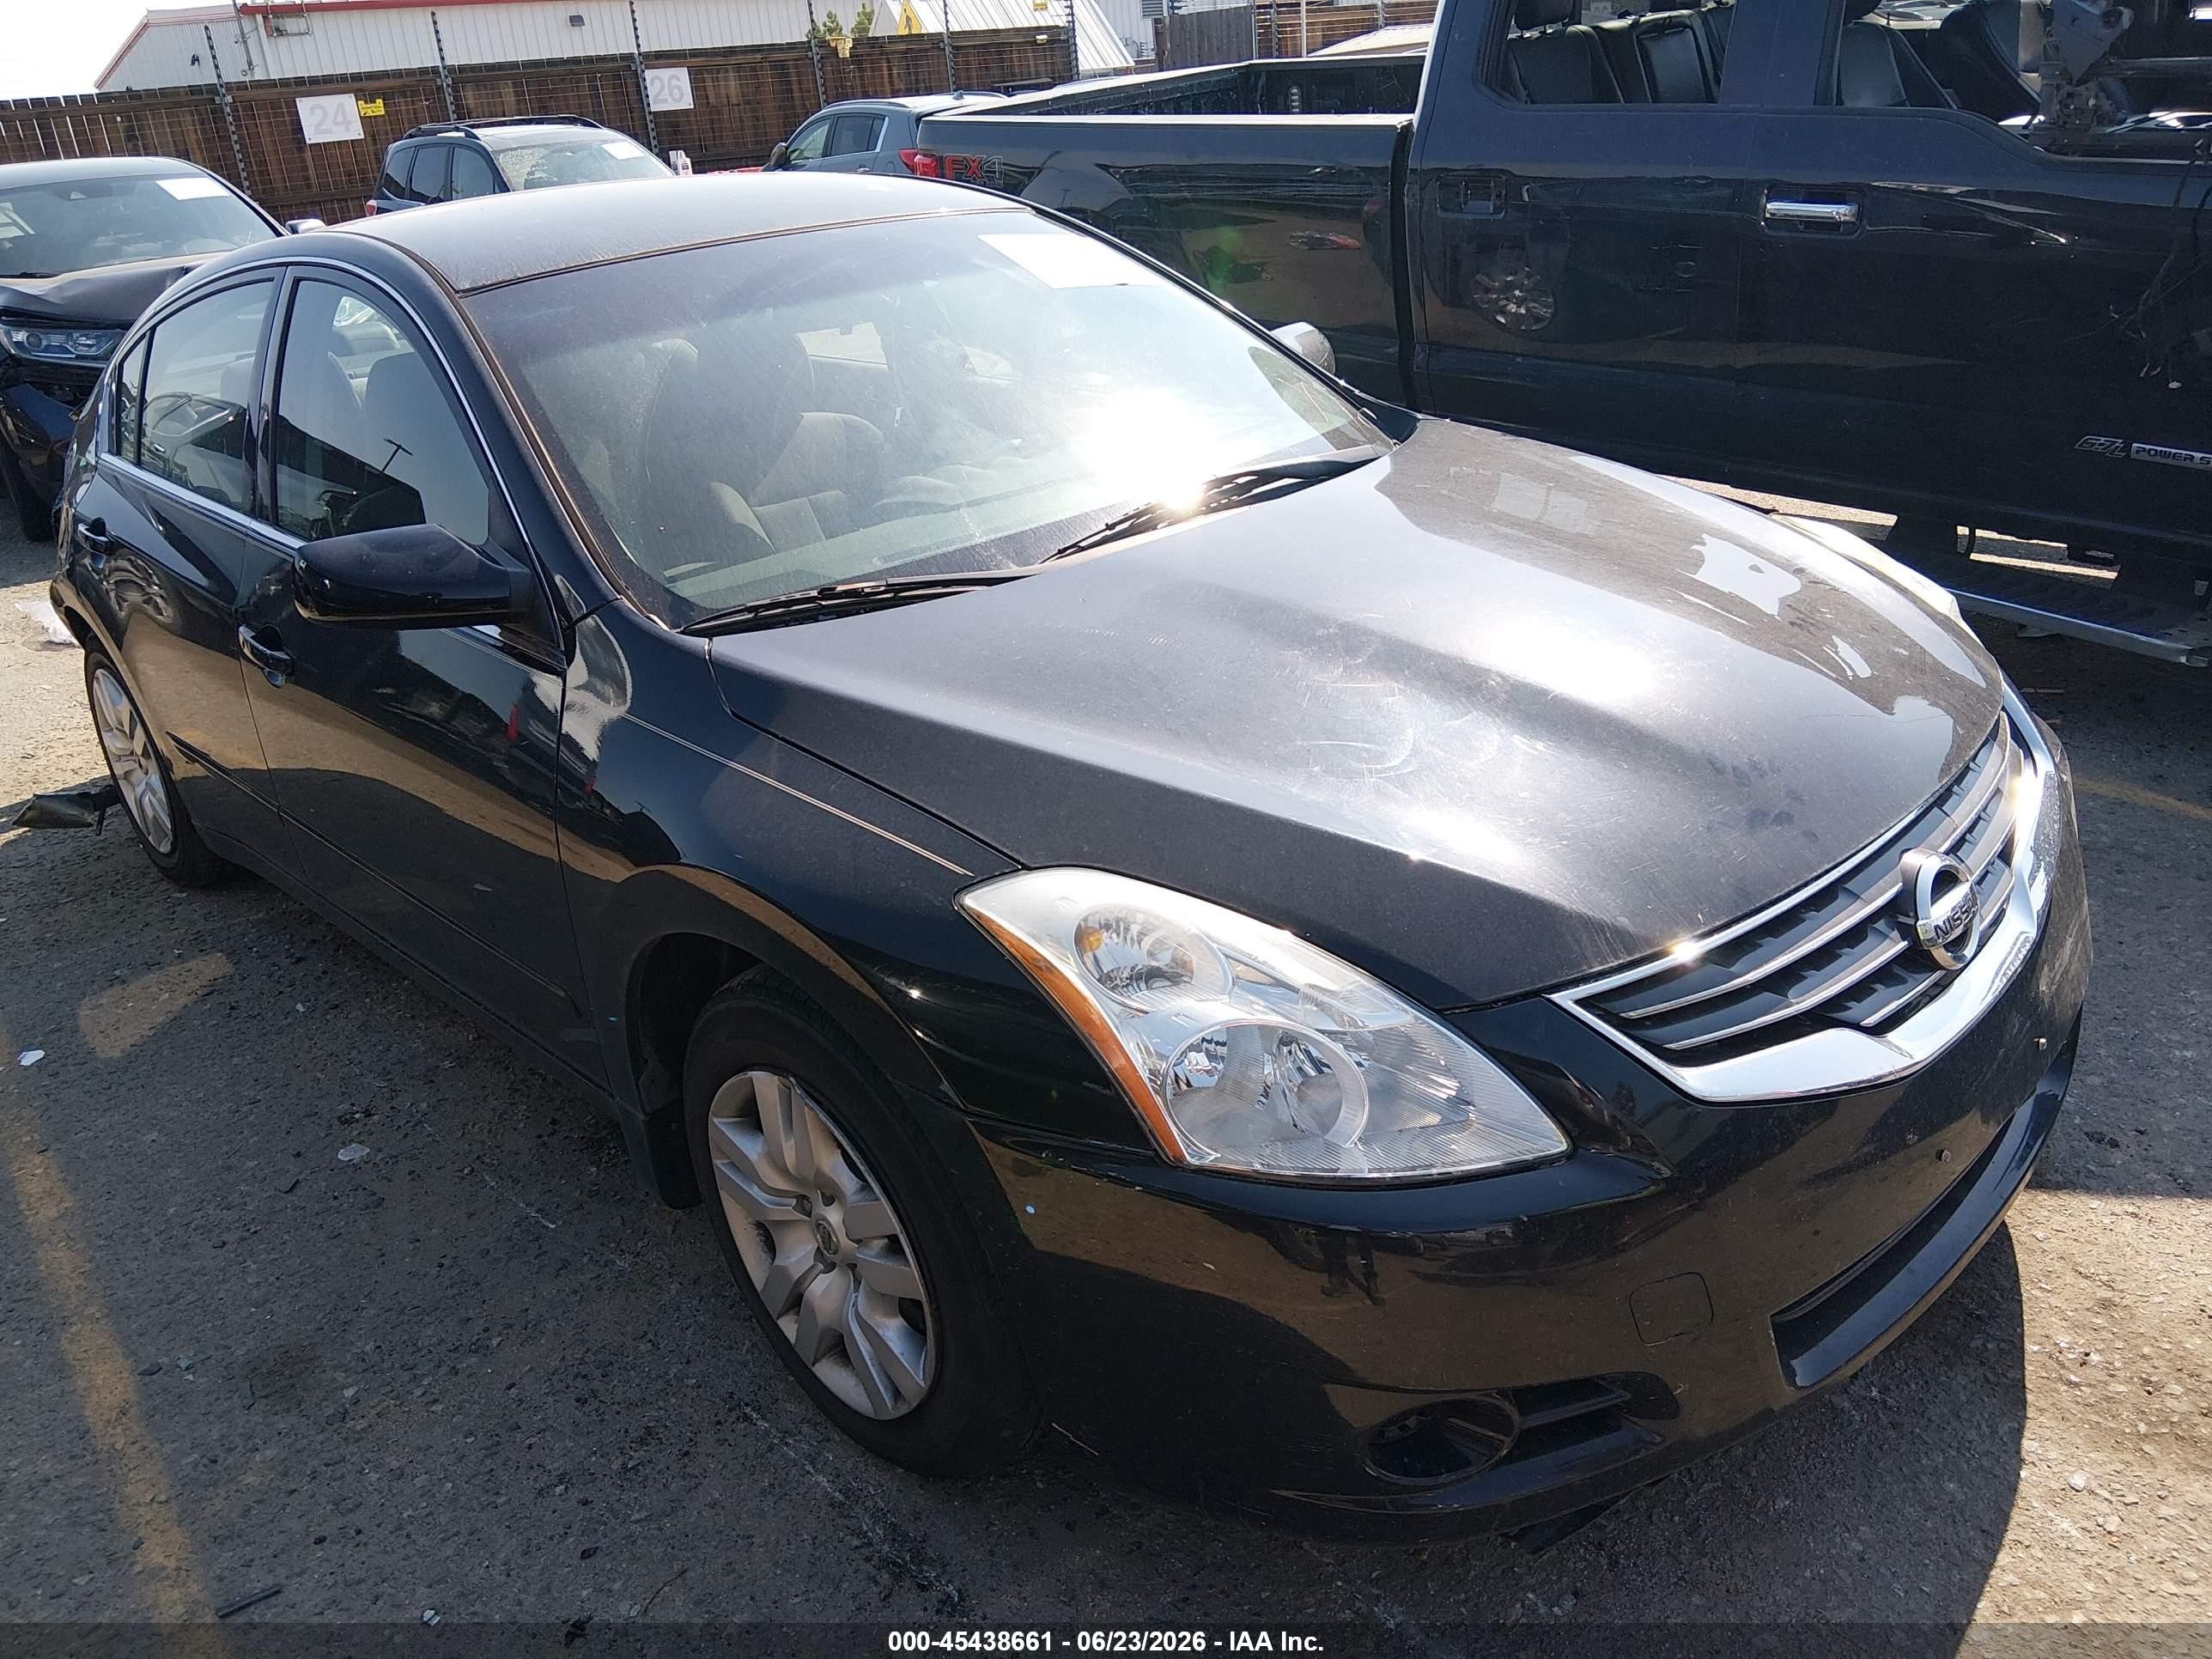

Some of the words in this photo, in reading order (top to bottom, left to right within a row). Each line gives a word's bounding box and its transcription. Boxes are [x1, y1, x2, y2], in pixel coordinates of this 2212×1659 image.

[649, 74, 684, 104] 26
[310, 102, 356, 136] 24
[944, 153, 1004, 182] FX4
[2135, 446, 2195, 464] POWER
